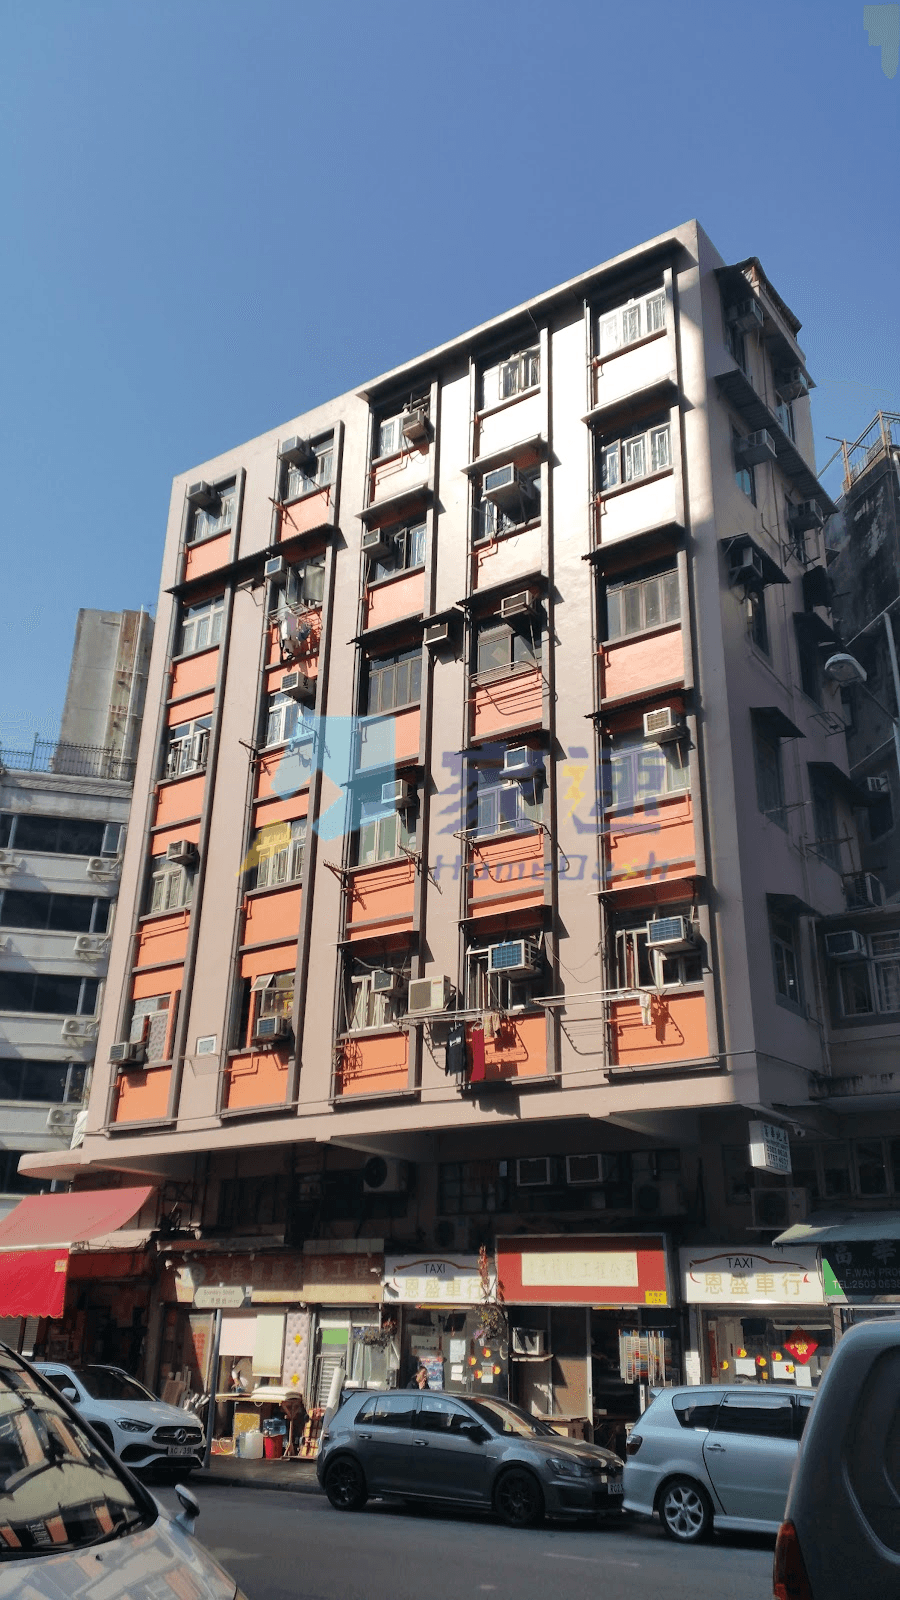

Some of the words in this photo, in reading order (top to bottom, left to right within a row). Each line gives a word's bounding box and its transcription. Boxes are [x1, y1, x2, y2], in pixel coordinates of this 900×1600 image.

[424, 1263, 446, 1274] TAXI
[726, 1257, 753, 1269] TAXI
[405, 1277, 486, 1299] 恩盛車行
[705, 1272, 801, 1296] 恩盛車行
